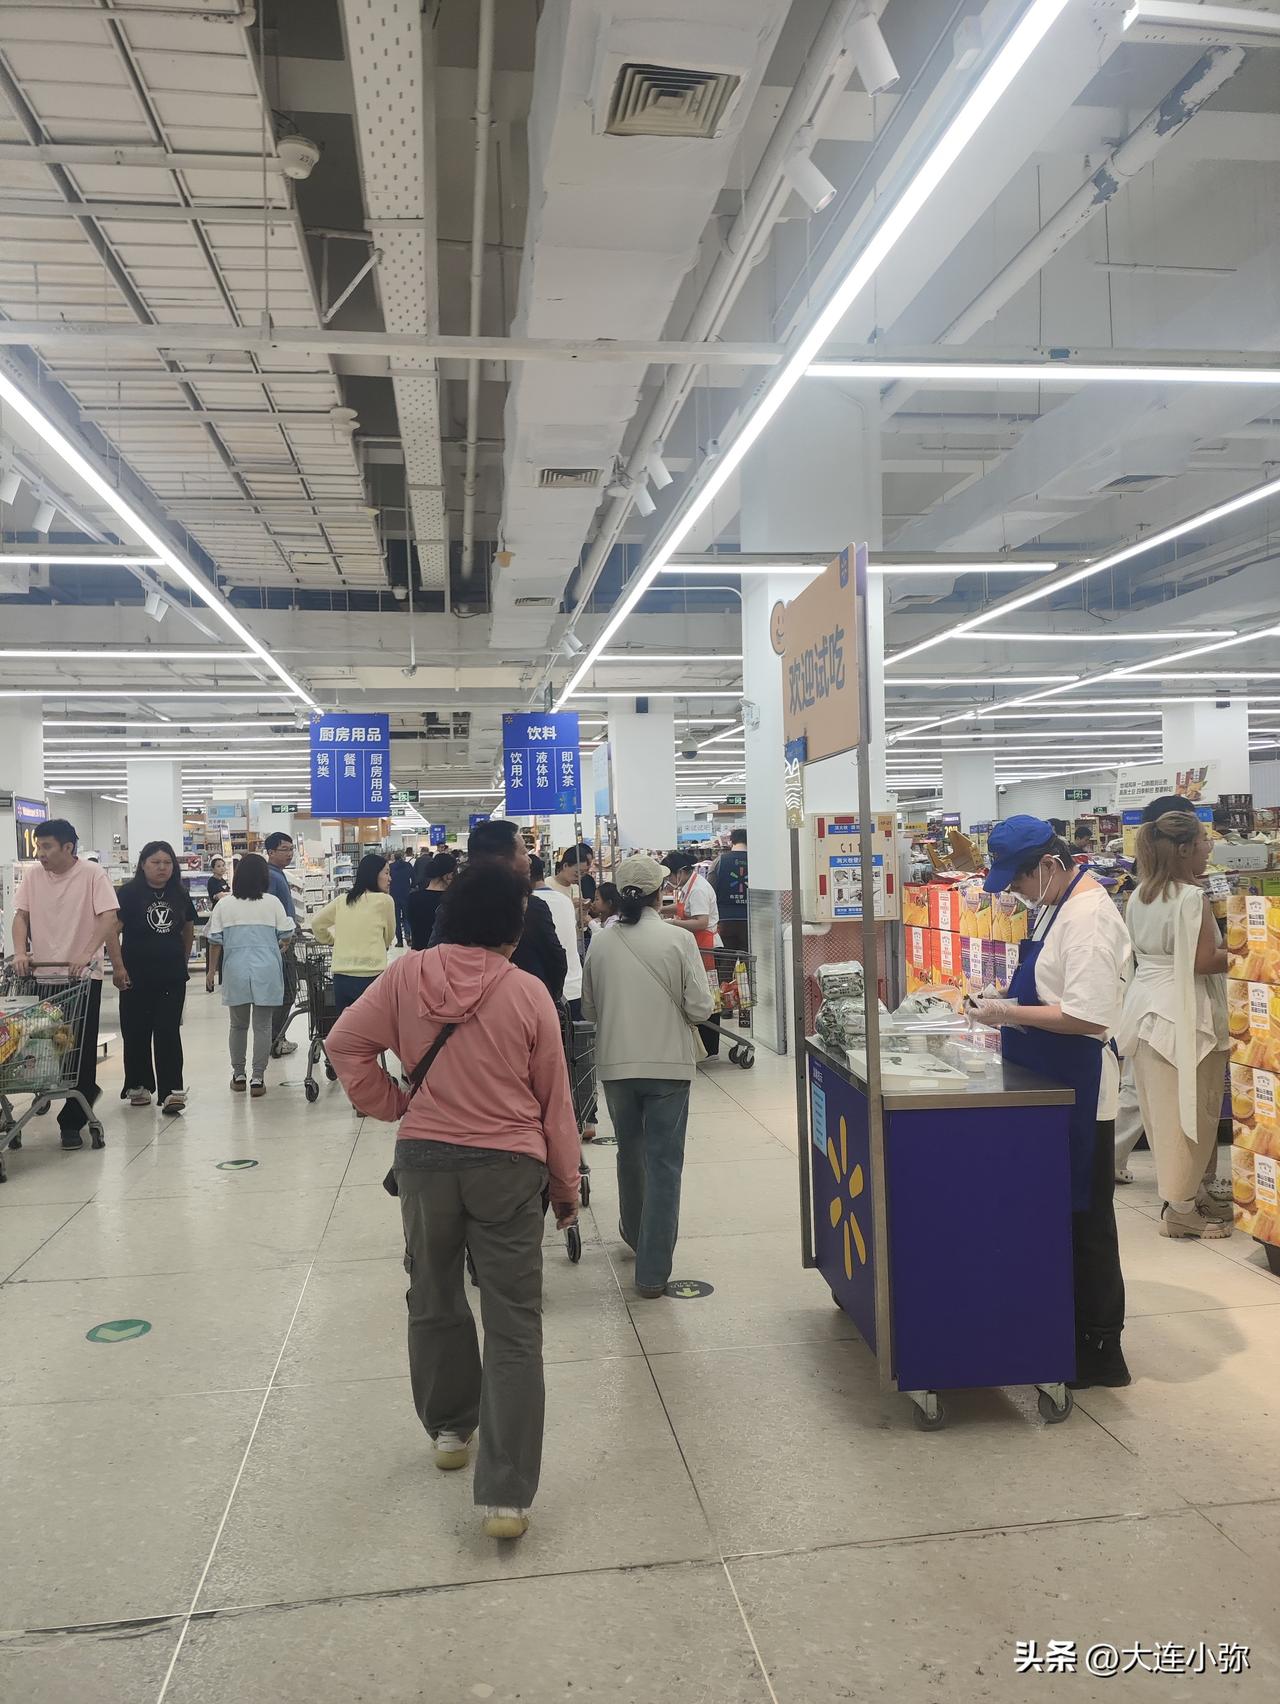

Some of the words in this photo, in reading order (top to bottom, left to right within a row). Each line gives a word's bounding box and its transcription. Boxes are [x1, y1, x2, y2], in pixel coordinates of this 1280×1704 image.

[789, 624, 845, 715] 欢迎试吃
[319, 727, 381, 742] 厨房用品
[527, 725, 557, 740] 饮料
[316, 753, 330, 778] 锅类
[343, 753, 356, 778] 餐具
[370, 753, 383, 802] 厨房用品
[510, 752, 523, 789] 饮用水
[536, 751, 549, 788] 液体奶
[561, 751, 574, 787] 即饮茶
